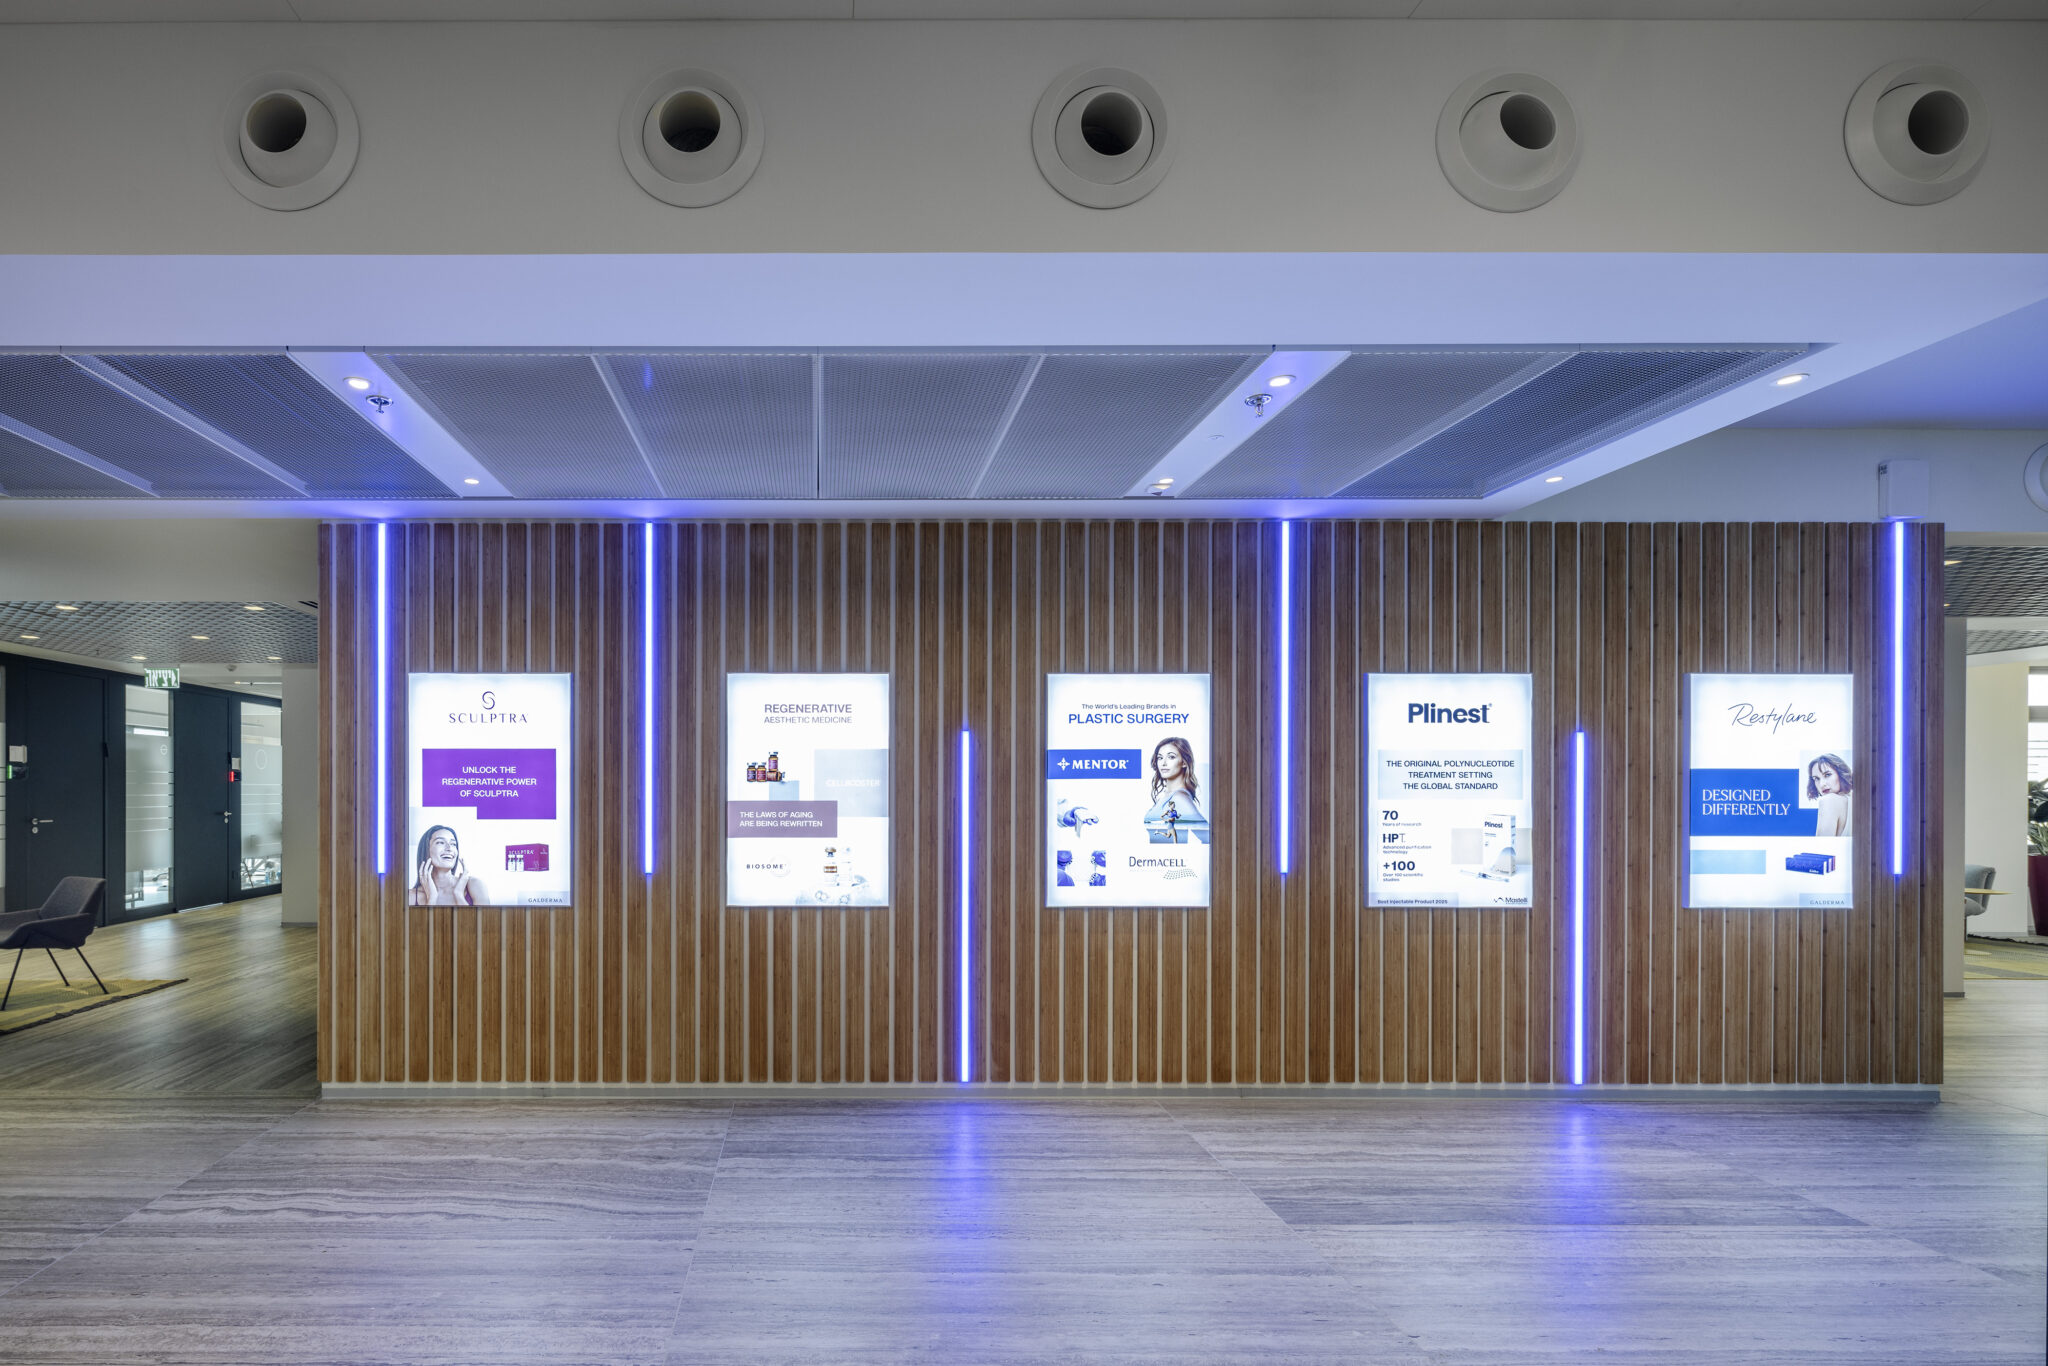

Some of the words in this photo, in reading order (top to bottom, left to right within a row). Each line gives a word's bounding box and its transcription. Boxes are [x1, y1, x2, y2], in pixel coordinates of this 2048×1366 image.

[146, 669, 171, 688] יציאה
[764, 703, 853, 714] REGENERATIVE
[1119, 703, 1145, 711] Leading
[448, 713, 528, 723] SCULPTRA
[764, 716, 810, 724] AESTHETIC
[811, 716, 852, 724] MEDICINE
[1068, 713, 1123, 724] PLASTIC
[1127, 713, 1190, 724] SURGERY
[1728, 703, 1817, 735] Restylane
[1404, 760, 1442, 768] ORIGINAL
[1444, 760, 1515, 768] POLYNUCLEOTIDE
[462, 766, 498, 774] UNLOCK
[500, 766, 517, 774] THE
[1408, 771, 1456, 779] TREATMENT
[1458, 771, 1493, 779] SETTING
[442, 778, 505, 786] REGENERATIVE
[506, 778, 537, 786] POWER
[1403, 782, 1419, 790] THE
[1420, 782, 1453, 790] GLOBAL
[1455, 782, 1498, 790] STANDARD
[460, 789, 472, 798] OF
[474, 789, 519, 798] SCULPTRA
[1702, 789, 1771, 802] DESIGNED
[1702, 803, 1791, 816] DIFFERENTLY
[1382, 810, 1399, 821] 70
[1383, 860, 1416, 871] +100
